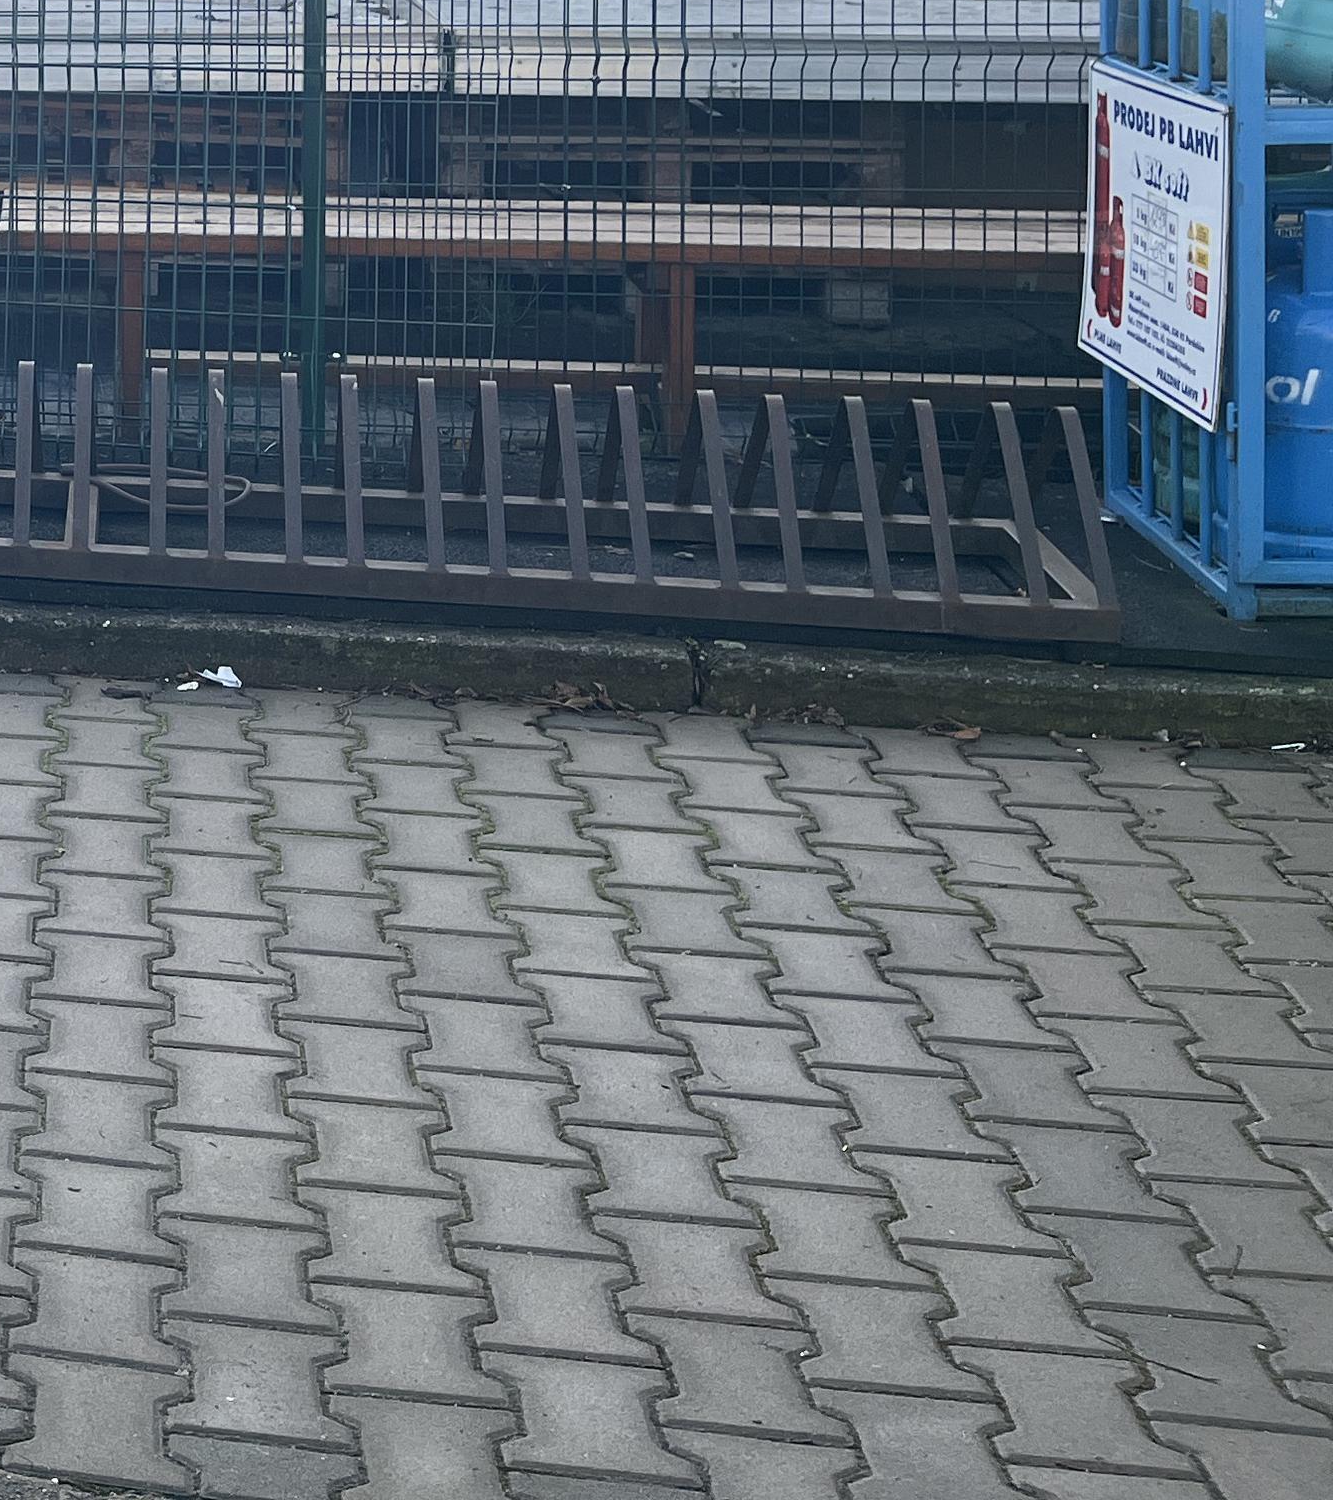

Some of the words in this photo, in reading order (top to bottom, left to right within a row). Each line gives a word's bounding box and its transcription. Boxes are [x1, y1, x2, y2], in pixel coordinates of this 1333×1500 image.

[1113, 99, 1155, 138] PRODEJ
[1159, 115, 1175, 145] PB
[1178, 124, 1219, 162] LAHVÍ
